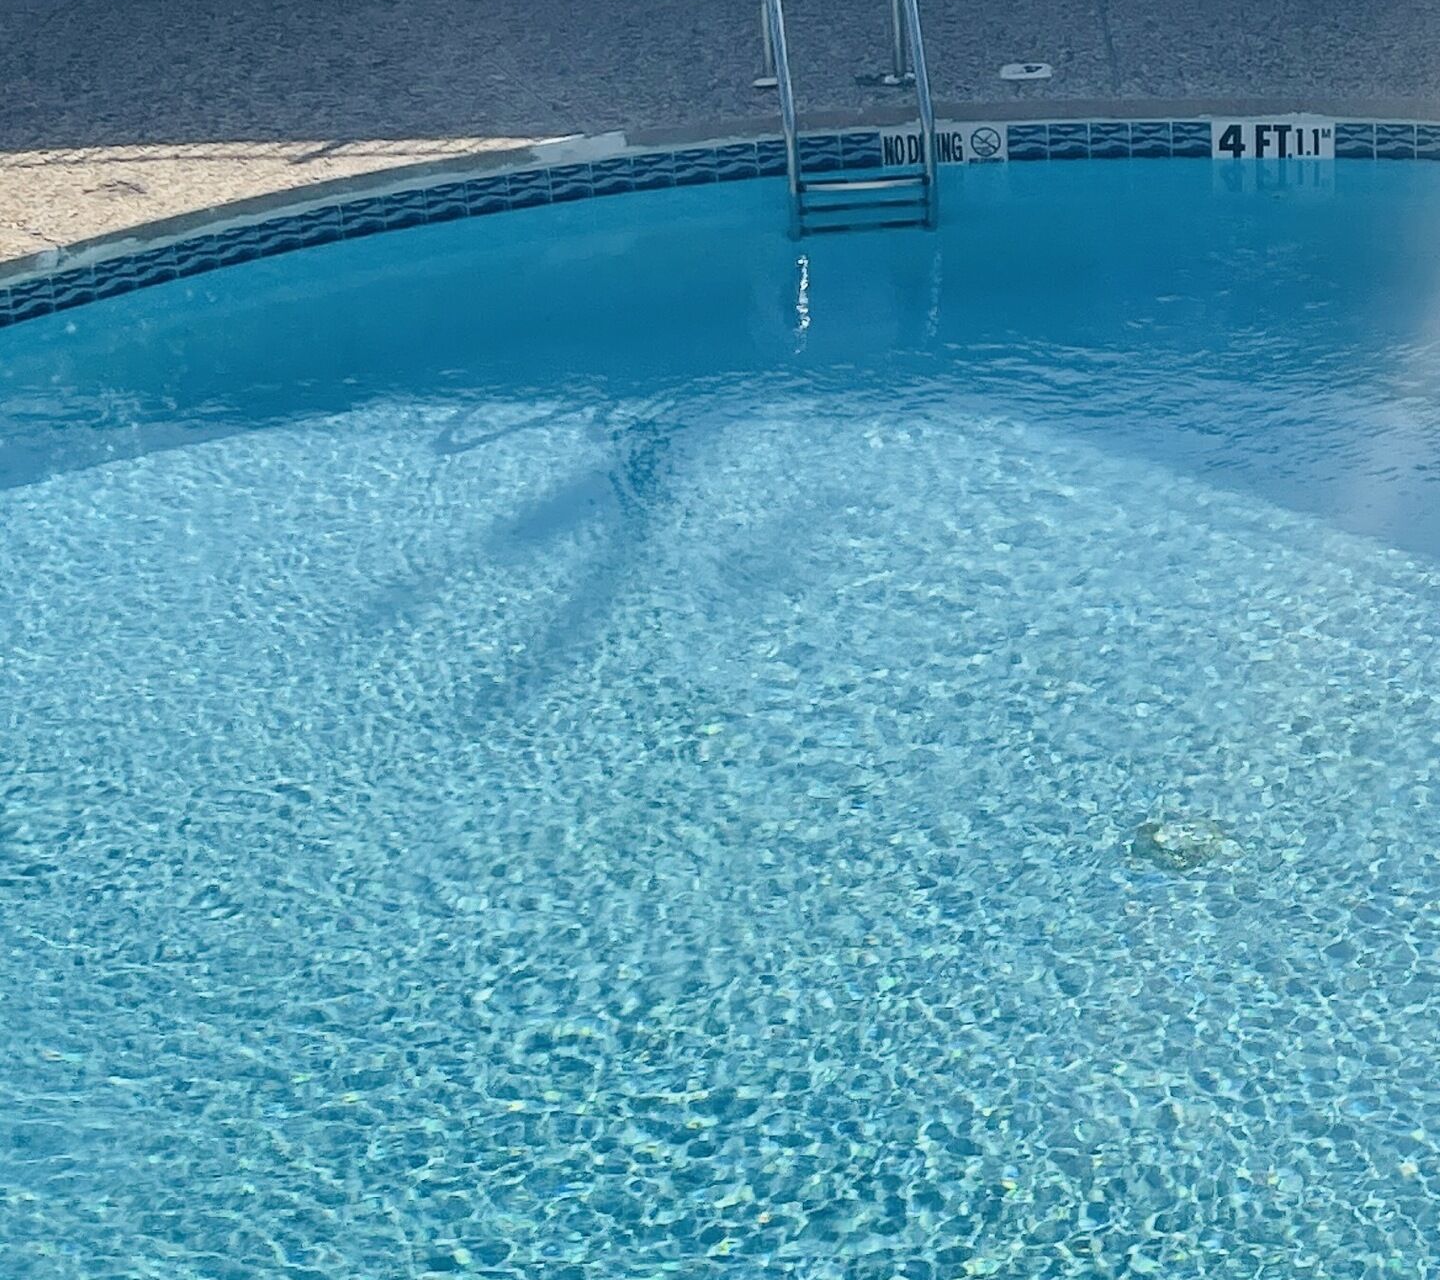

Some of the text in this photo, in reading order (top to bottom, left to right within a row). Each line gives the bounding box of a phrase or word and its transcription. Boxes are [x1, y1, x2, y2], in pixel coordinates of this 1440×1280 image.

[883, 132, 964, 165] NO DIING
[1219, 124, 1246, 158] 4
